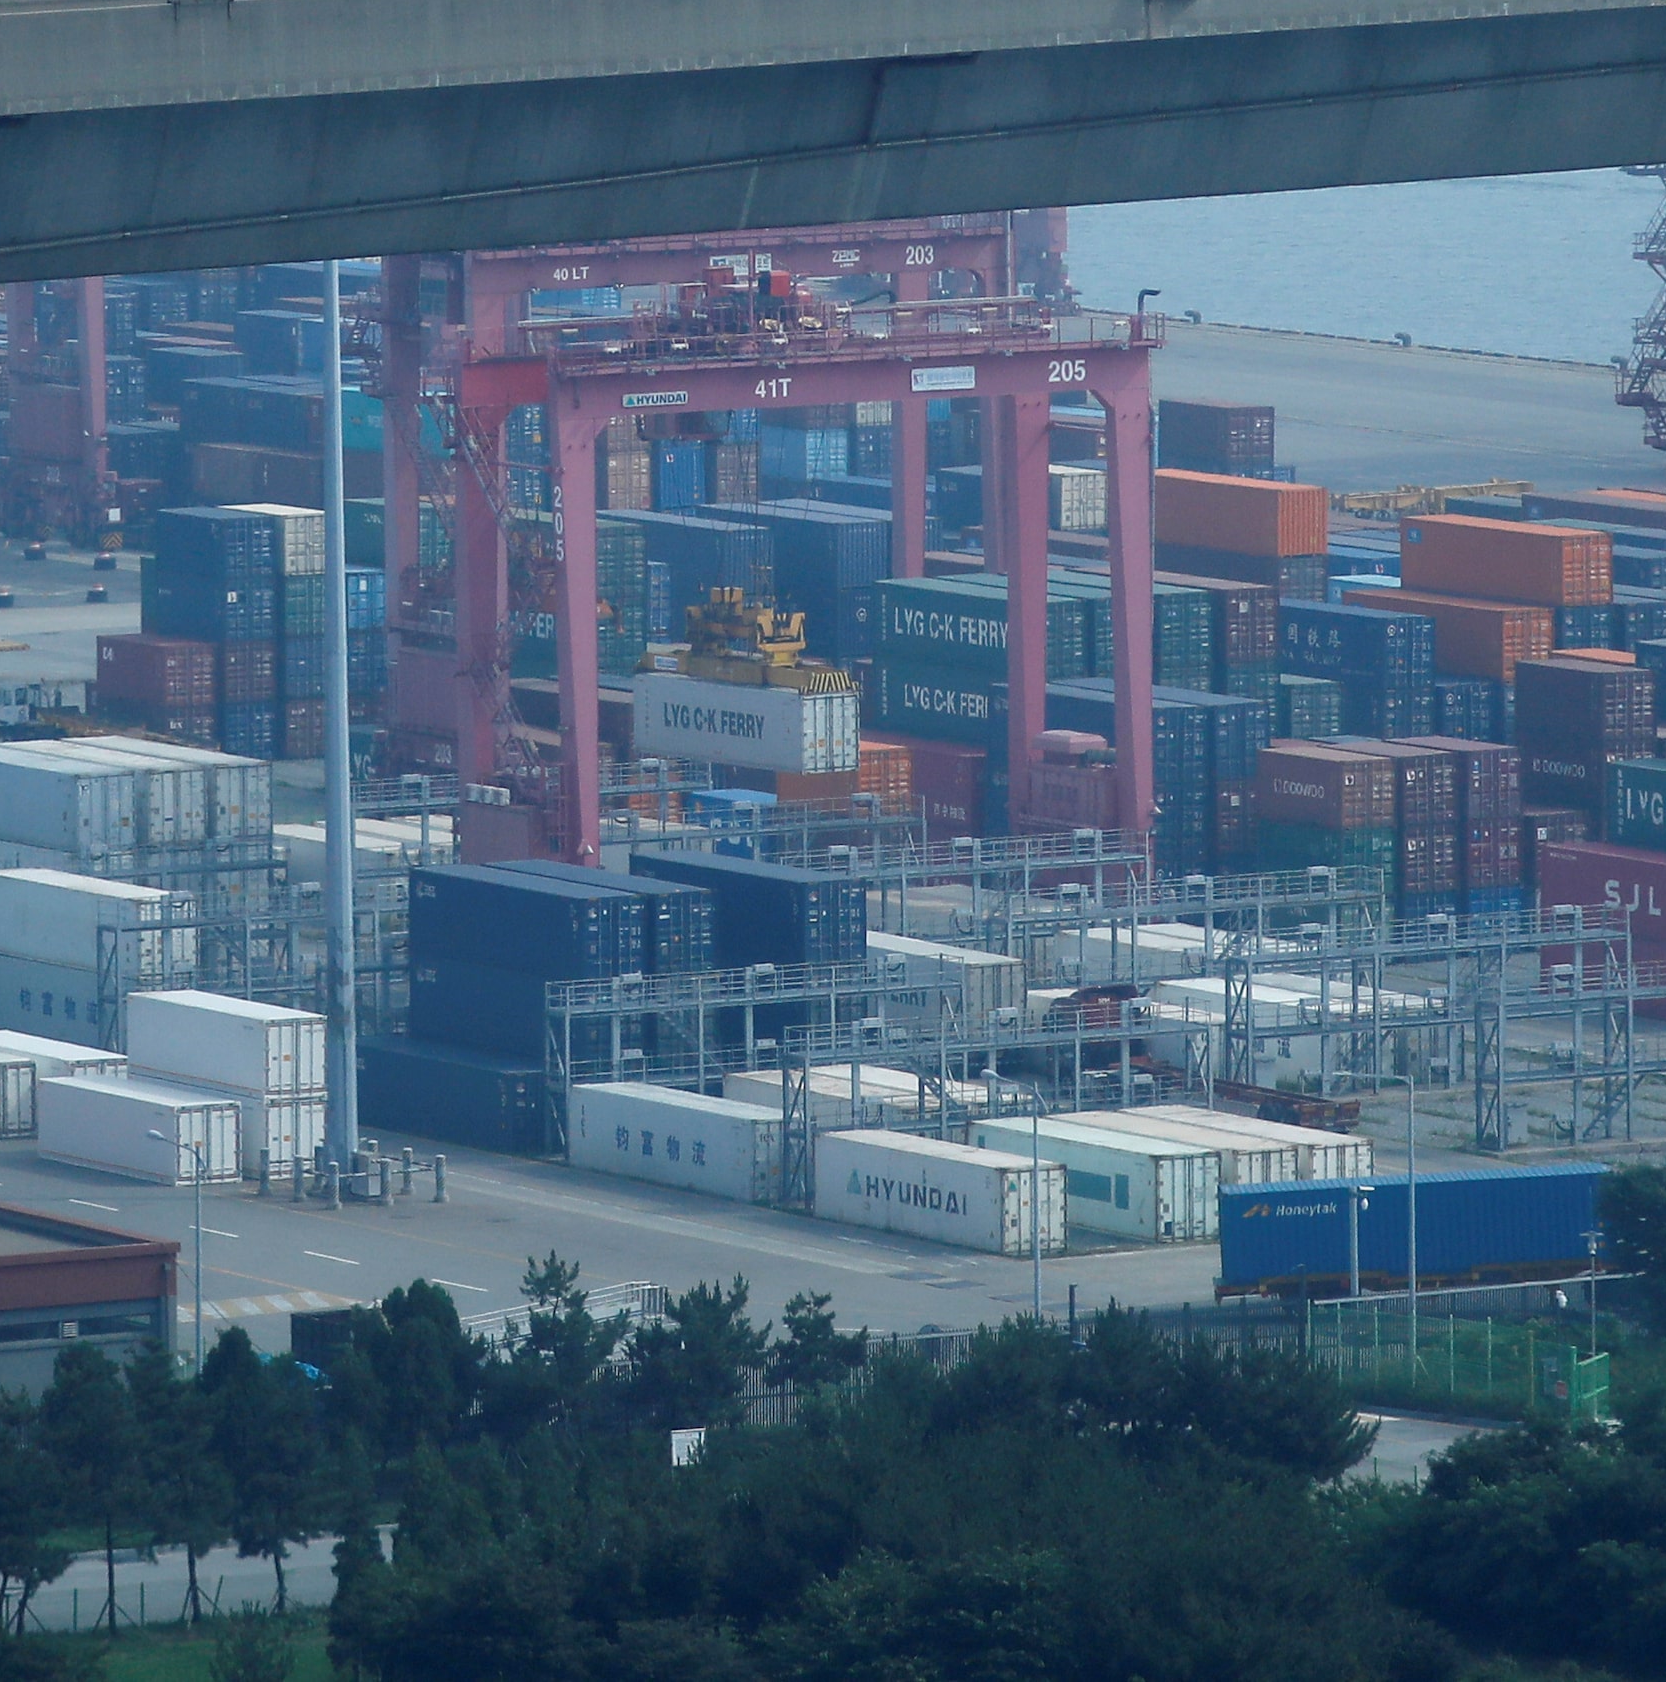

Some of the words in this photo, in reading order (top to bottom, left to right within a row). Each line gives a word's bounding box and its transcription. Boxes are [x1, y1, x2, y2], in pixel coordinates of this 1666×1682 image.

[905, 245, 935, 266] 203
[553, 267, 569, 281] 40
[572, 266, 590, 280] LT
[1048, 359, 1086, 383] 205
[636, 393, 687, 405] HYUNDAI
[754, 378, 792, 399] 41T
[553, 485, 565, 563] 205
[893, 606, 925, 637] LYG
[928, 611, 954, 642] C-K
[960, 615, 1009, 649] FERRY
[903, 682, 931, 711] LYG
[933, 688, 957, 716] C-K
[663, 701, 690, 728] LYG
[693, 706, 718, 733] C-K
[720, 710, 765, 740] FERRY
[1626, 787, 1664, 826] LYG
[865, 1174, 967, 1216] HYUNDAI
[1275, 1202, 1337, 1217] Honeytak
